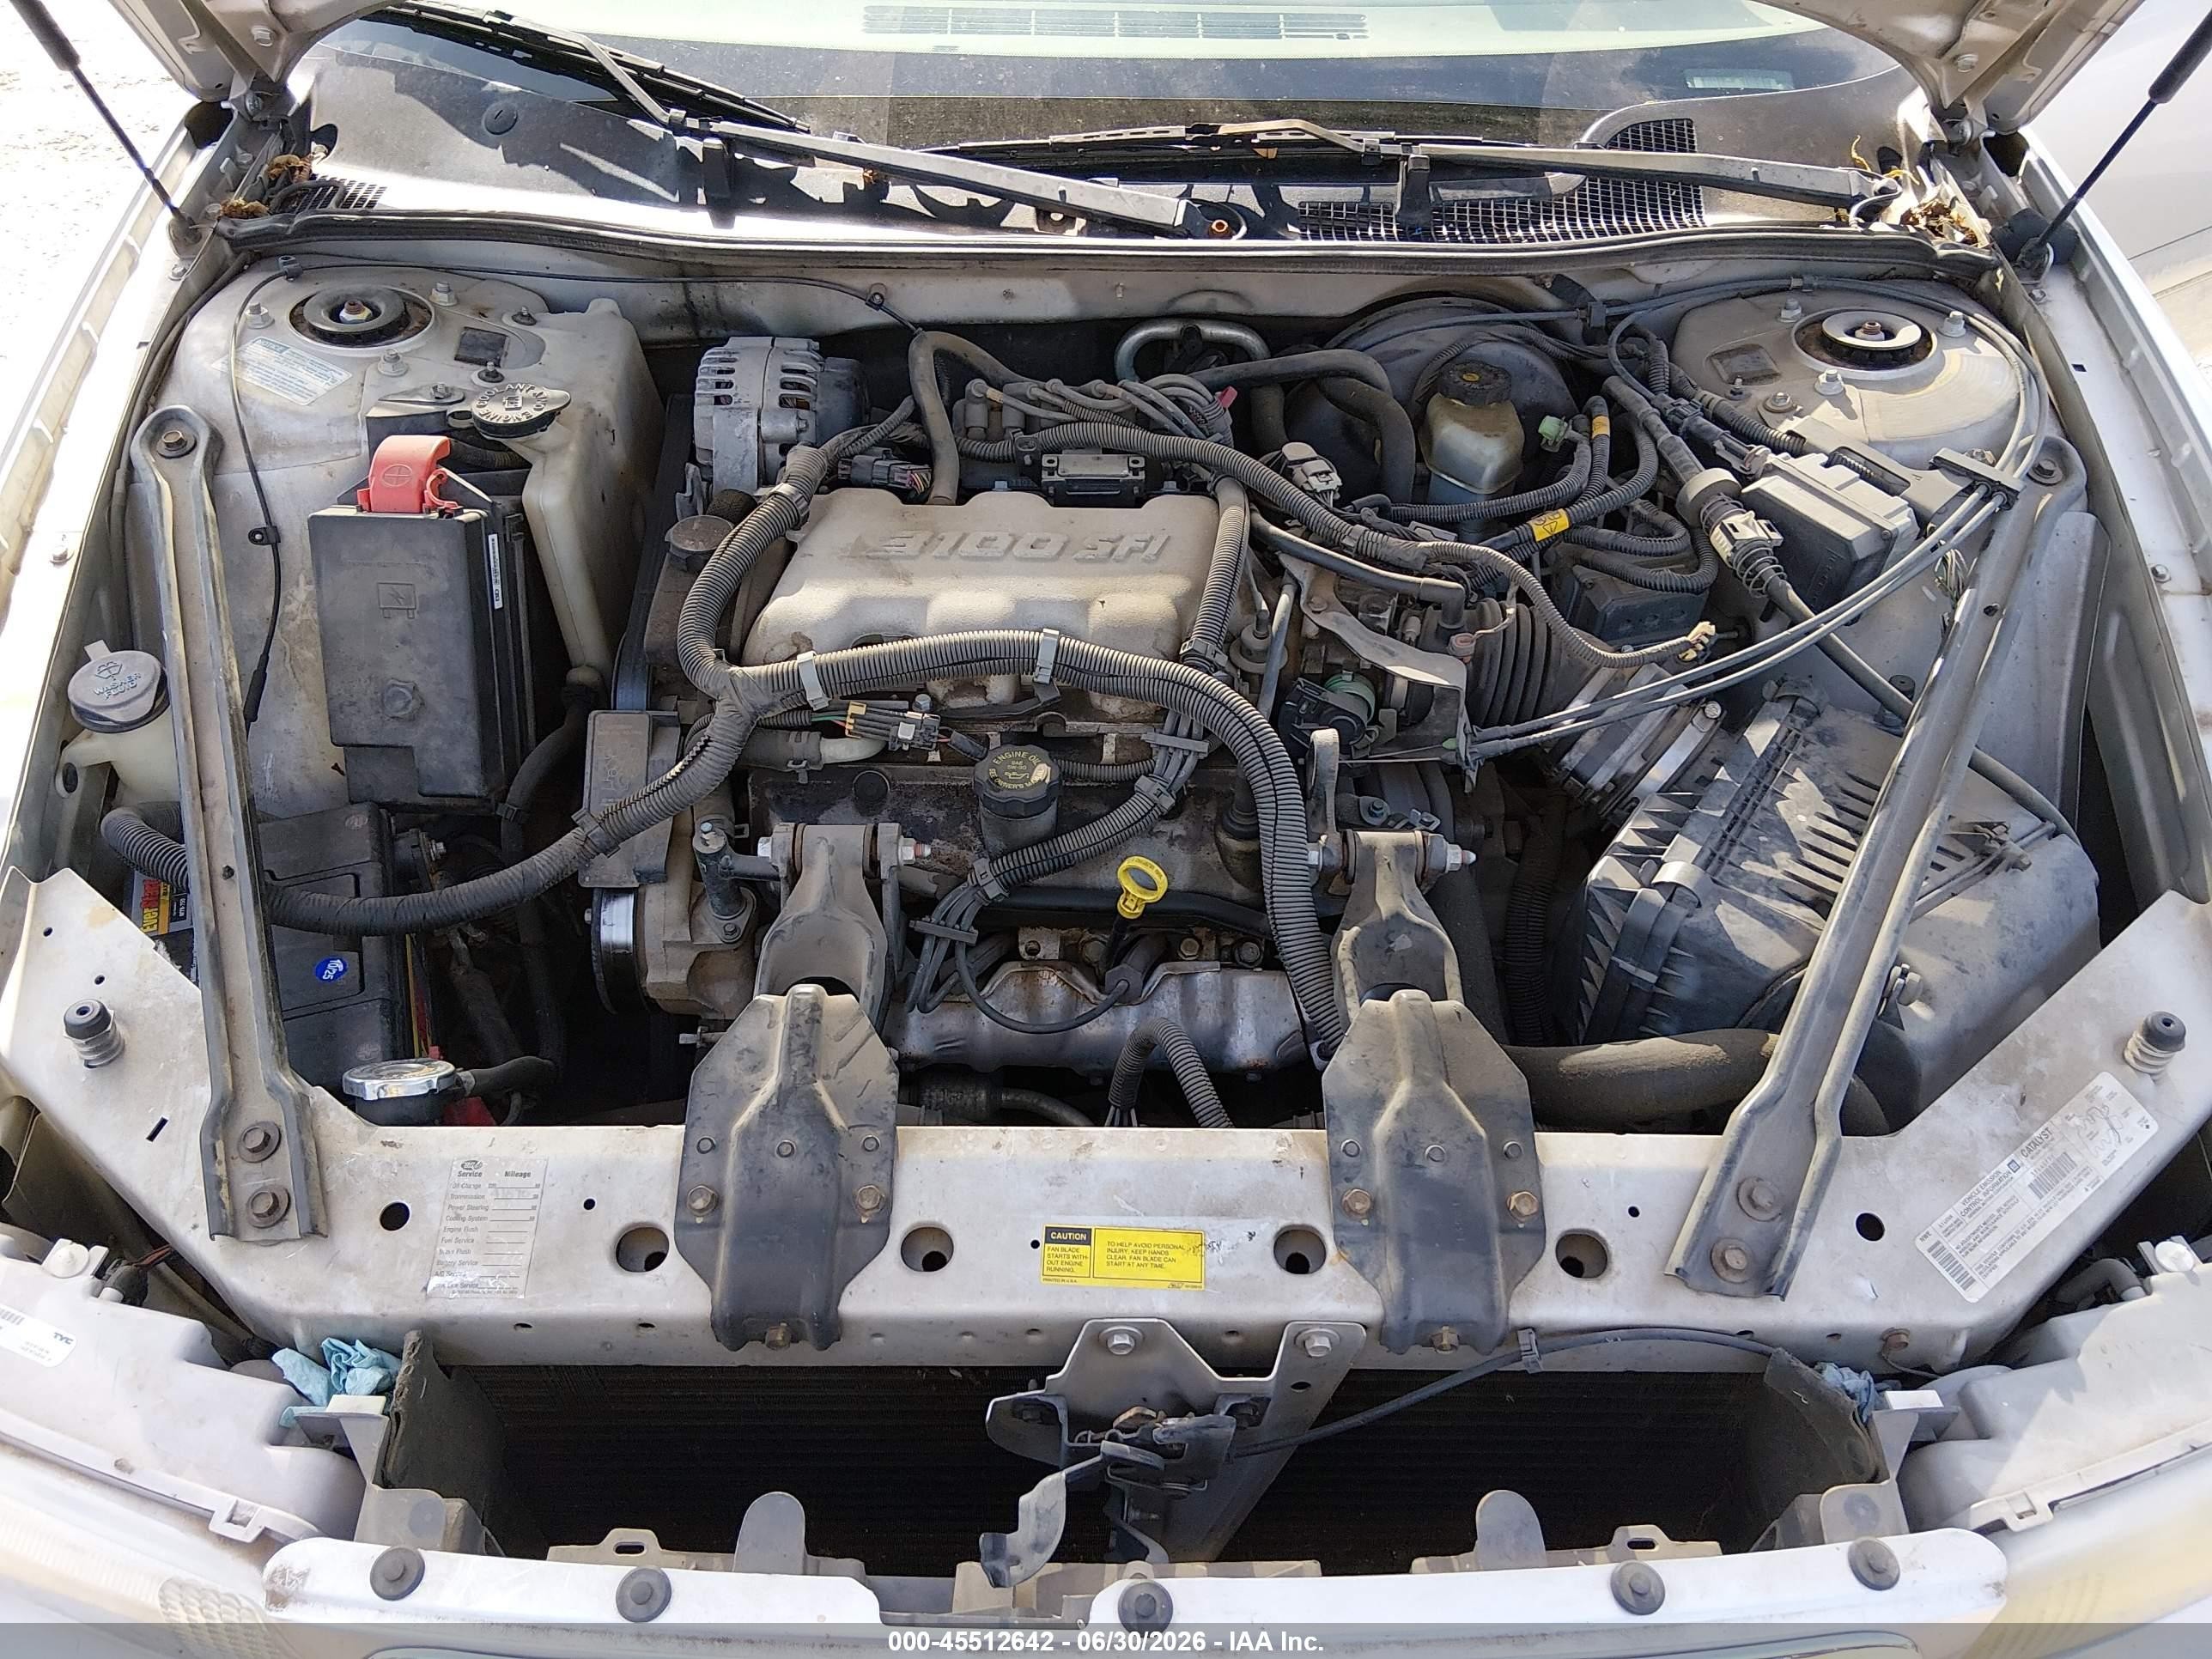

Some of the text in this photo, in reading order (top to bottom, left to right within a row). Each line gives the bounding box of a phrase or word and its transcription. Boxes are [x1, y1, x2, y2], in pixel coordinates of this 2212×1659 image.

[477, 383, 536, 407] COOLANT
[479, 410, 532, 422] ENGINE
[866, 531, 1170, 563] 3100 SFI
[94, 673, 142, 695] WASHER
[104, 682, 137, 700] FLUID
[993, 750, 1042, 765] ENGINE OIL
[322, 960, 338, 980] 10/25
[2019, 1126, 2054, 1158] CATALYST
[1960, 1169, 2002, 1206] VEHICLE EMISSION
[1960, 1170, 2012, 1217] CONTROL INFORMATION
[53, 1332, 73, 1345] TYC
